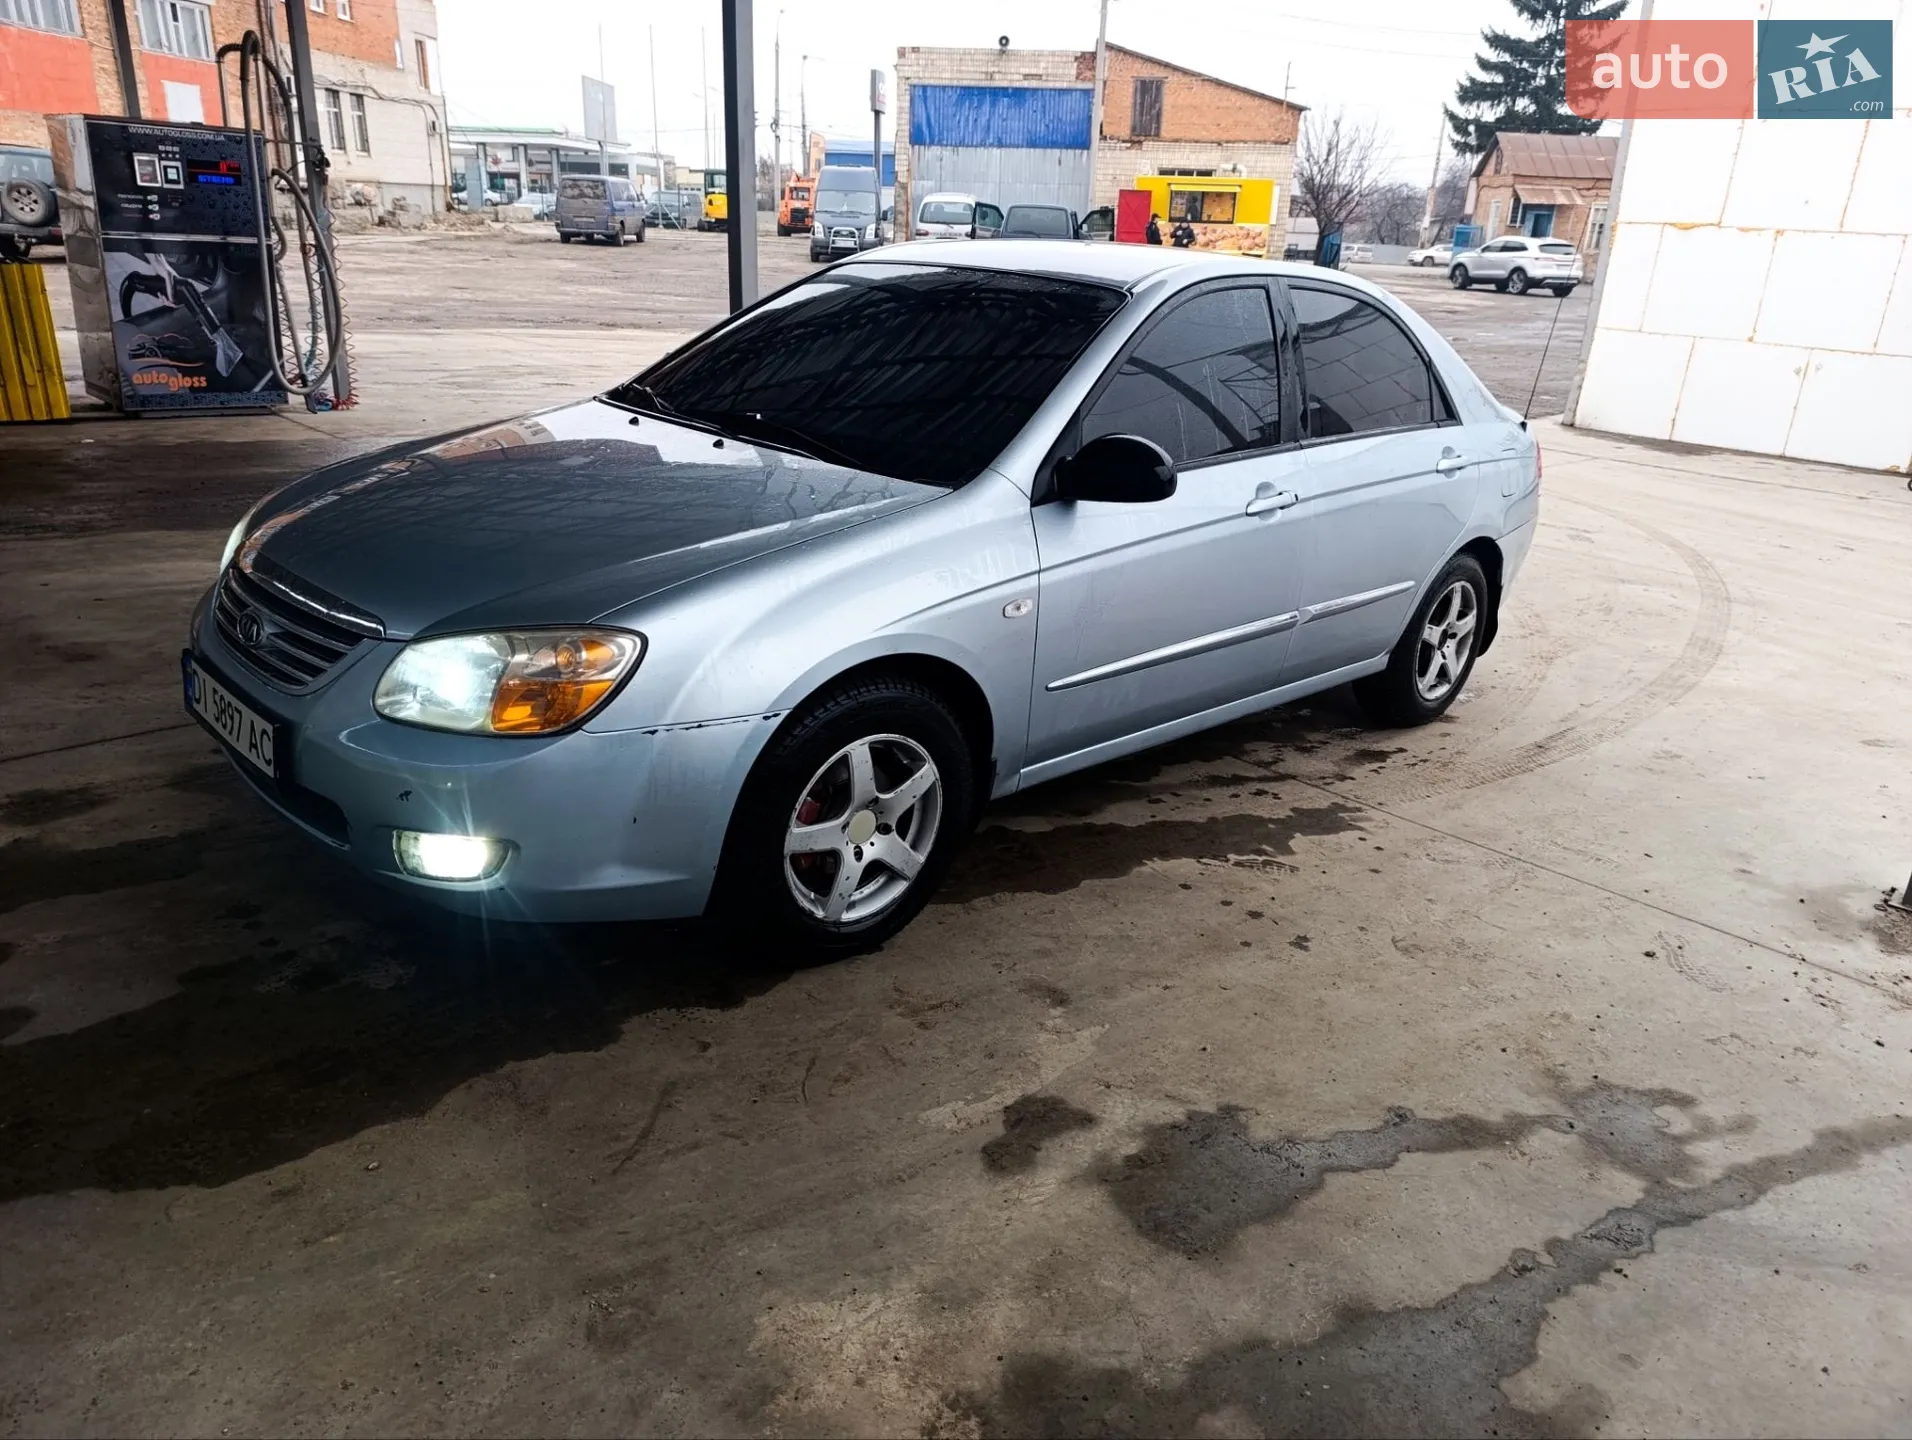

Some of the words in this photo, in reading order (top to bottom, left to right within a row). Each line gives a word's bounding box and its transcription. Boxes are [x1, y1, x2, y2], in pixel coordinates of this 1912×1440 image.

[128, 126, 225, 141] WWW.AUTOGLOSS.COM.UA
[132, 370, 207, 392] autogloss
[193, 668, 208, 713] DI
[212, 687, 243, 743] 5897
[249, 719, 273, 767] AC
